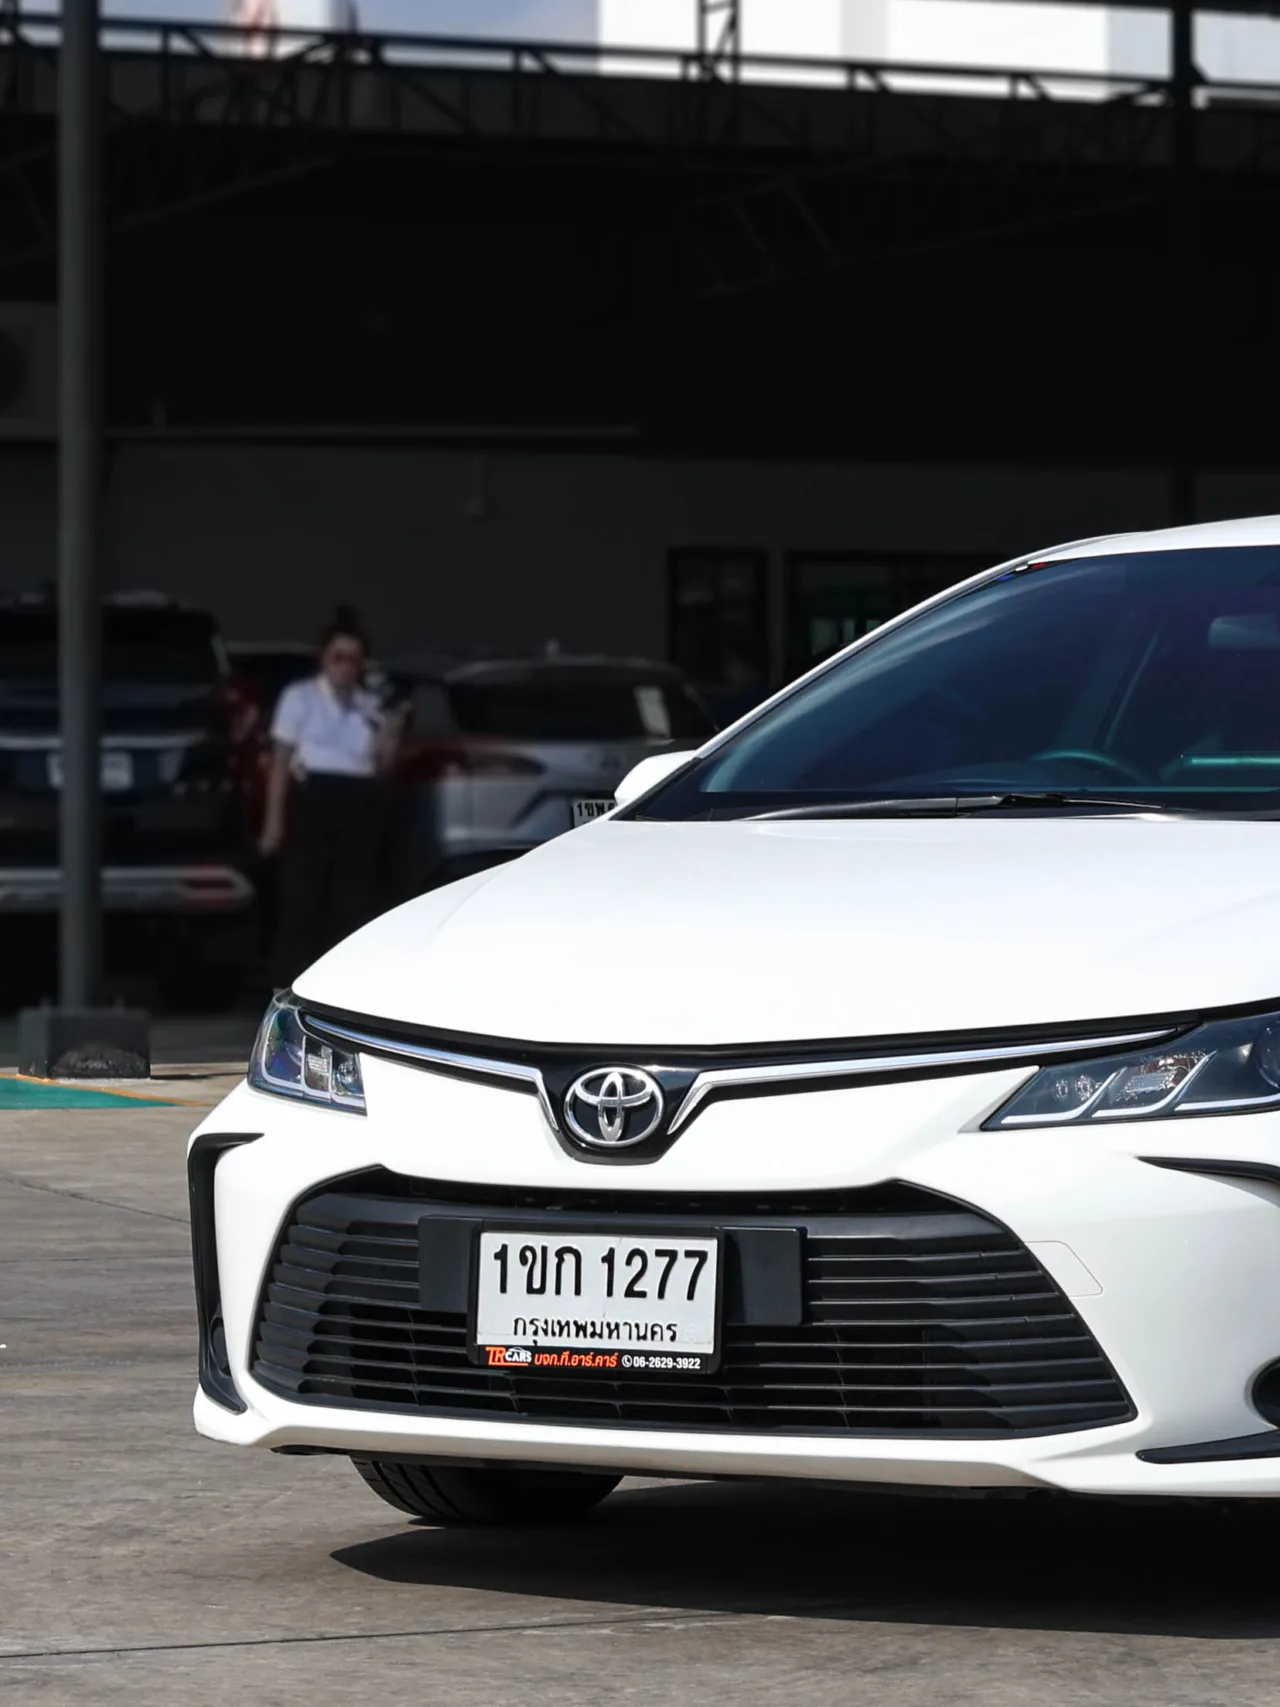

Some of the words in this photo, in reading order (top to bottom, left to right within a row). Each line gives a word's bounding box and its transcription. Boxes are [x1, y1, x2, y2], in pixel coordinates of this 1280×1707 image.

[493, 1243, 582, 1296] 1ขก
[601, 1247, 708, 1300] 1277
[513, 1317, 678, 1346] กรุงเทพมหานคร
[633, 1356, 701, 1369] 06-2629-3922
